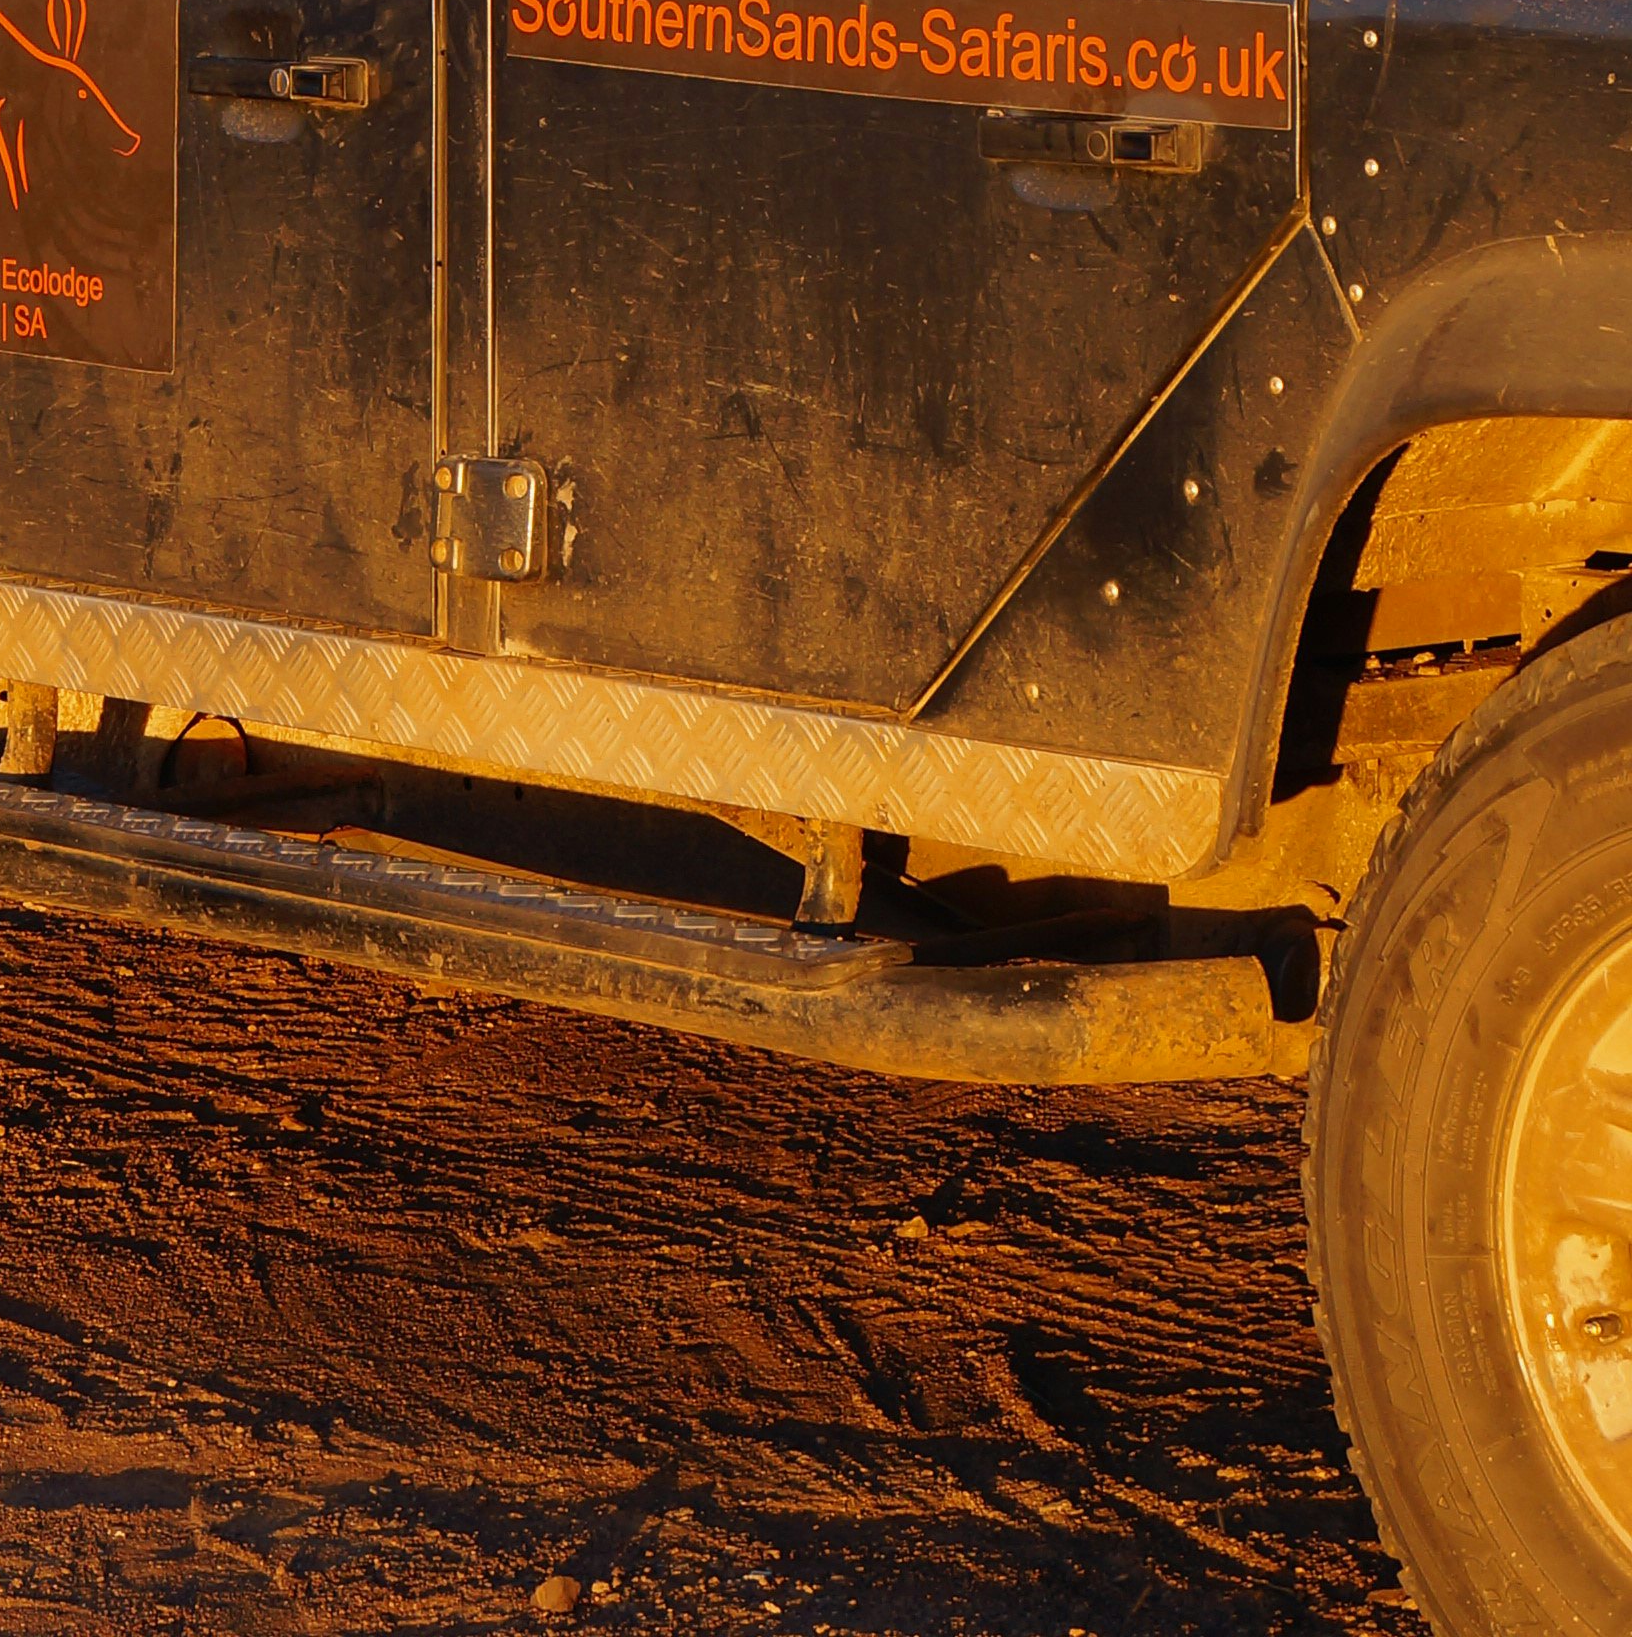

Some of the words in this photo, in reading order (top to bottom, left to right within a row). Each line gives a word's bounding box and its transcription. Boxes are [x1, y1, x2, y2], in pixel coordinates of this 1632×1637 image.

[2, 258, 104, 307] Ecolodge
[14, 305, 48, 339] SA
[1362, 911, 1540, 1637] RANGLER
